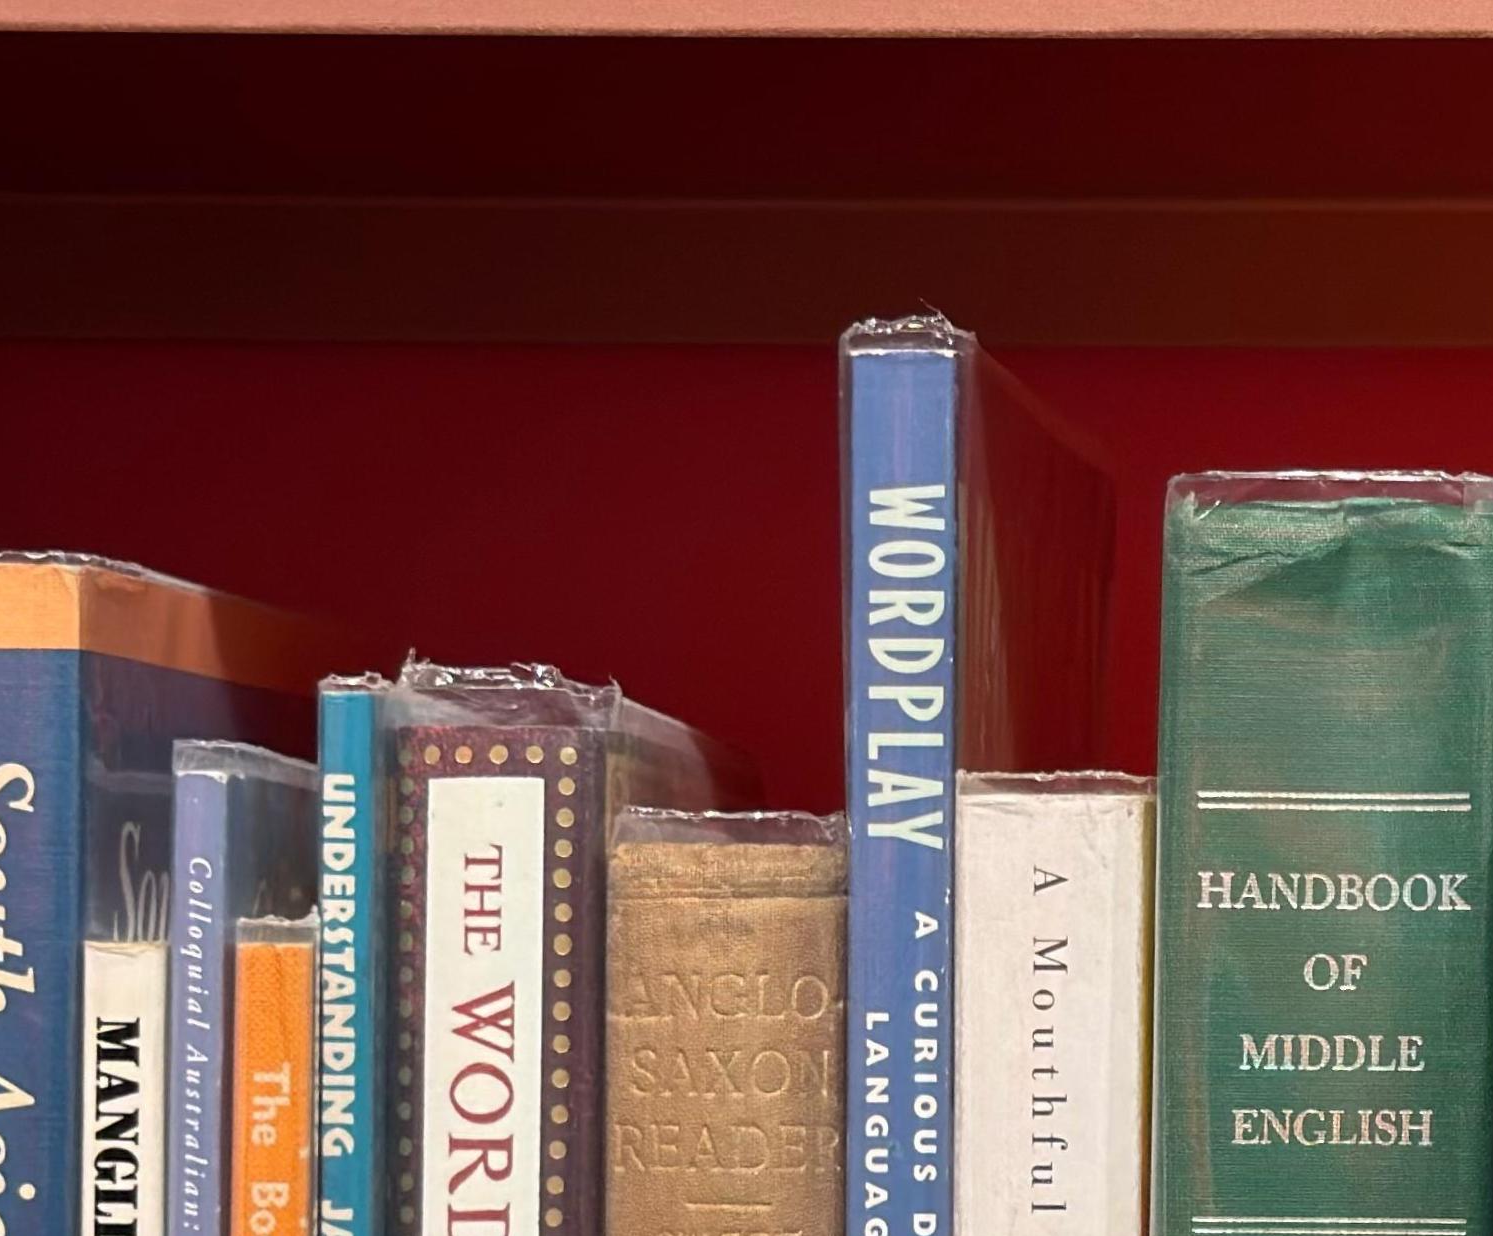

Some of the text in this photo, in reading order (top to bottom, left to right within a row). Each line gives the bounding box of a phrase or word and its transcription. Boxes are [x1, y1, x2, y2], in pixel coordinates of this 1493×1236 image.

[865, 483, 944, 850] WORDPLAY
[462, 845, 502, 954] THE
[1032, 865, 1069, 895] A
[1196, 873, 1471, 913] HANDBOOK
[180, 856, 212, 1030] Colloquial
[913, 912, 938, 938] A
[322, 773, 356, 1158] UNDERSTANDING
[1303, 953, 1367, 992] OF
[632, 1049, 830, 1098] SAXON
[910, 972, 938, 1182] CURIOUS
[1029, 936, 1067, 1215] Mouthful
[1238, 1034, 1424, 1072] MIDDLE
[252, 1061, 291, 1146] The
[1231, 1108, 1432, 1149] ENGLISH
[183, 1044, 210, 1231] Australian:
[614, 1123, 840, 1172] READER
